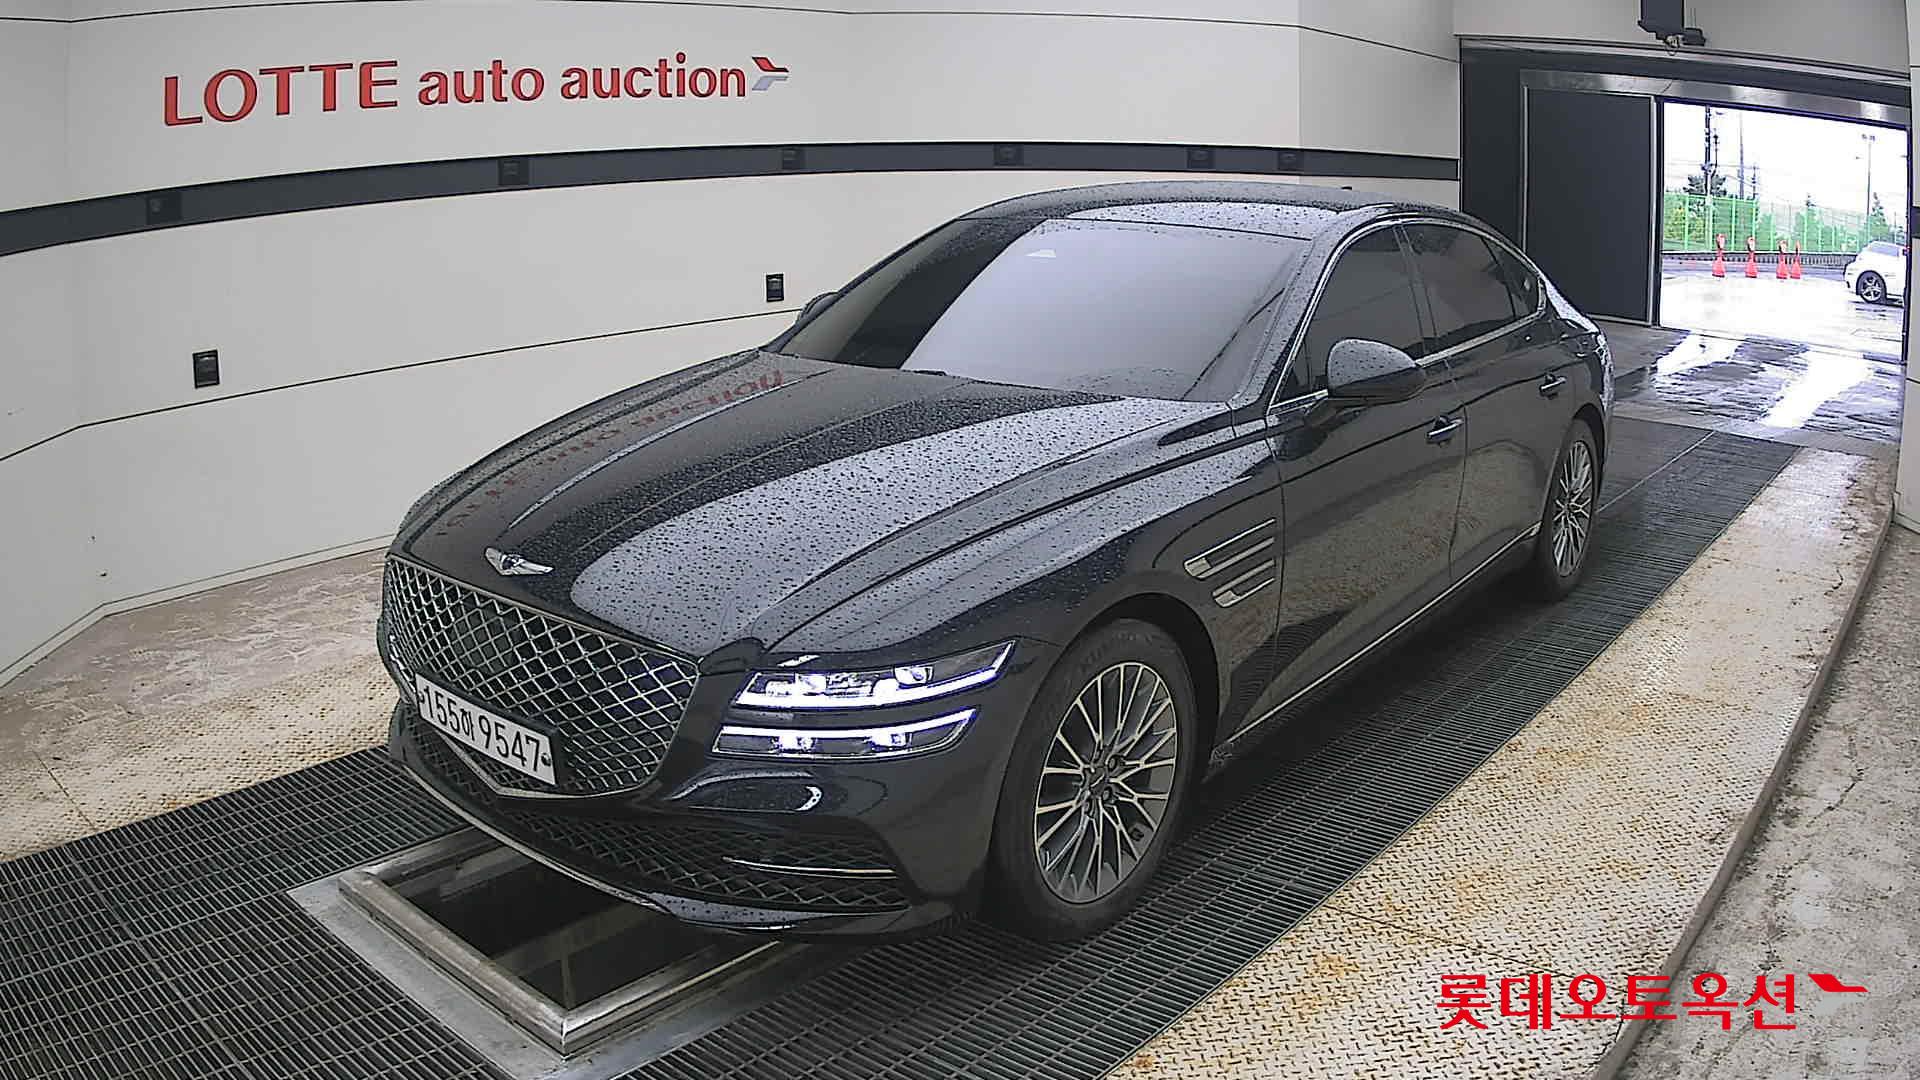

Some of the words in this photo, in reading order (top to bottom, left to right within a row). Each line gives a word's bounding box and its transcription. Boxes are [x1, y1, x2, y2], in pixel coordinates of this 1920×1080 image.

[164, 60, 398, 126] LOTTE
[418, 60, 545, 105] auto
[560, 52, 746, 99] auction
[478, 714, 540, 772] 9547
